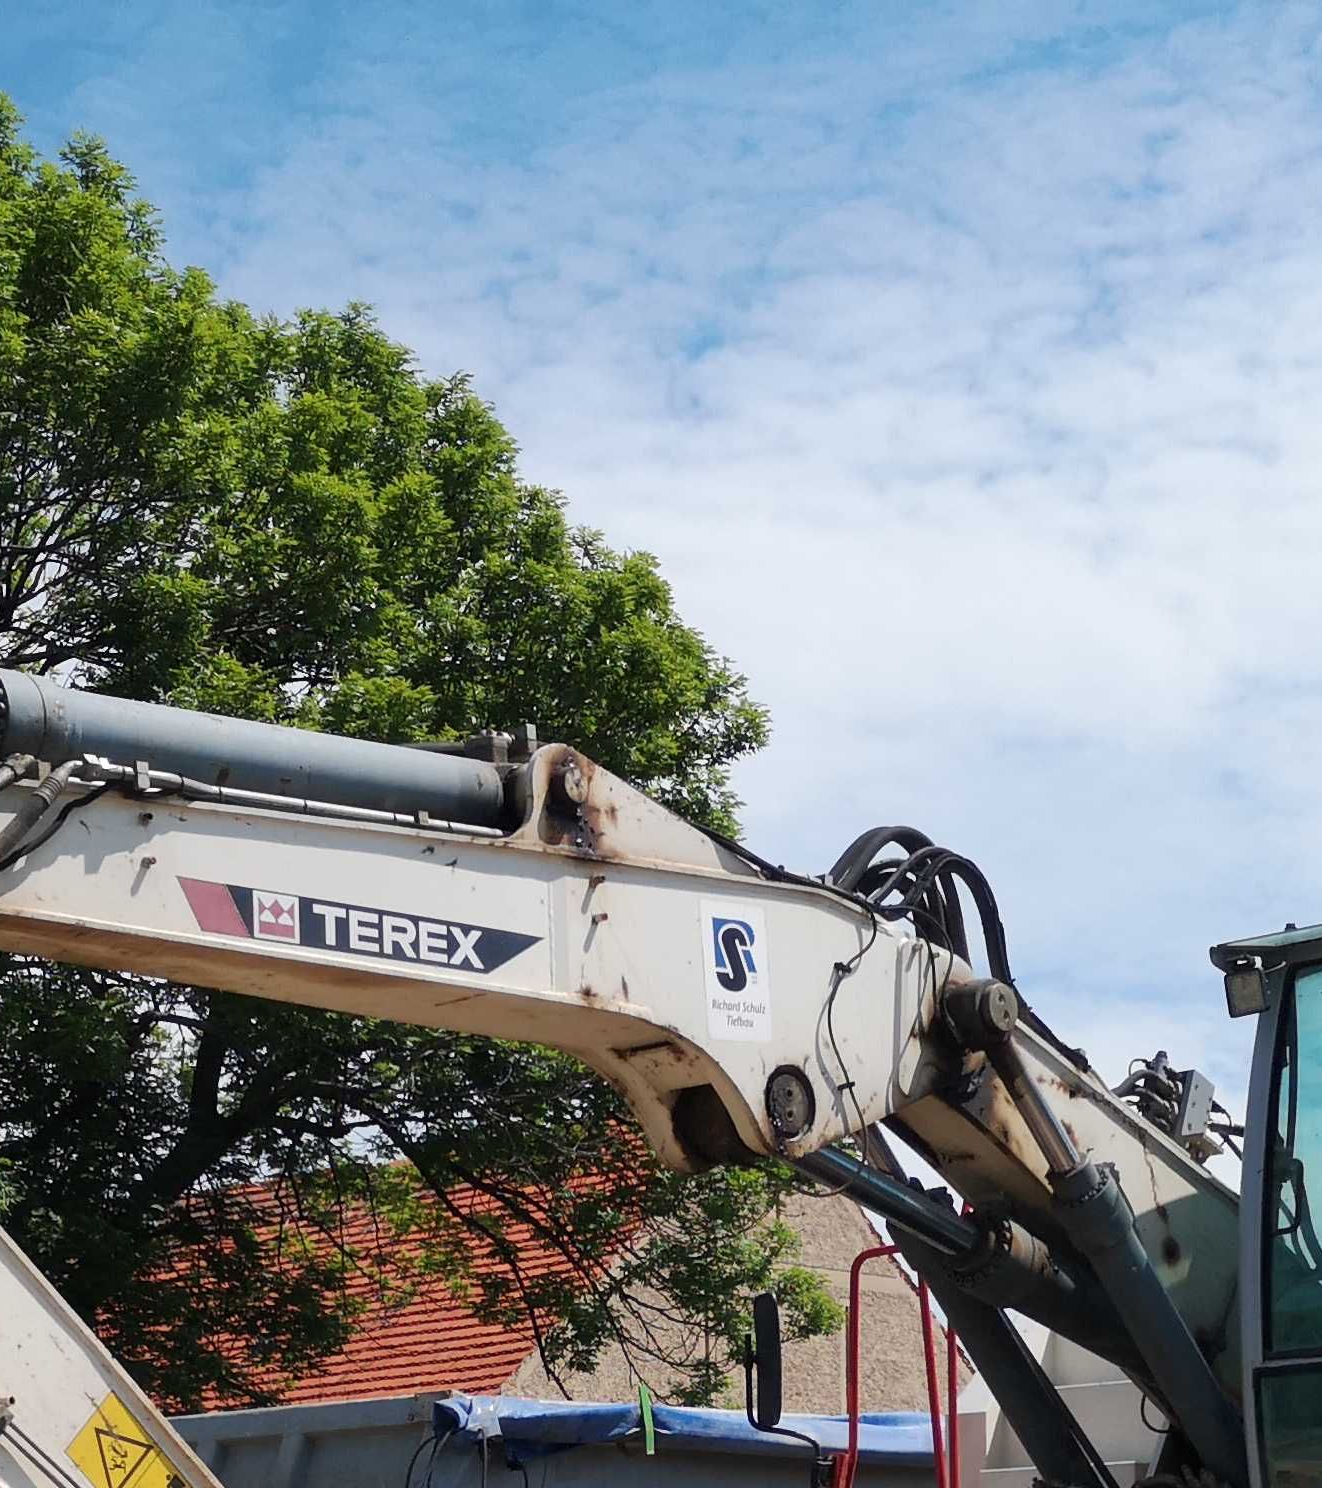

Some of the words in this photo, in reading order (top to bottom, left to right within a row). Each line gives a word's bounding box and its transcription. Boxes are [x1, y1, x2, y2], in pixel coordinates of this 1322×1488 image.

[313, 903, 485, 971] TEREX
[711, 999, 741, 1012] Richard
[742, 1001, 766, 1015] Schulz
[726, 1015, 754, 1028] Tiefbau
